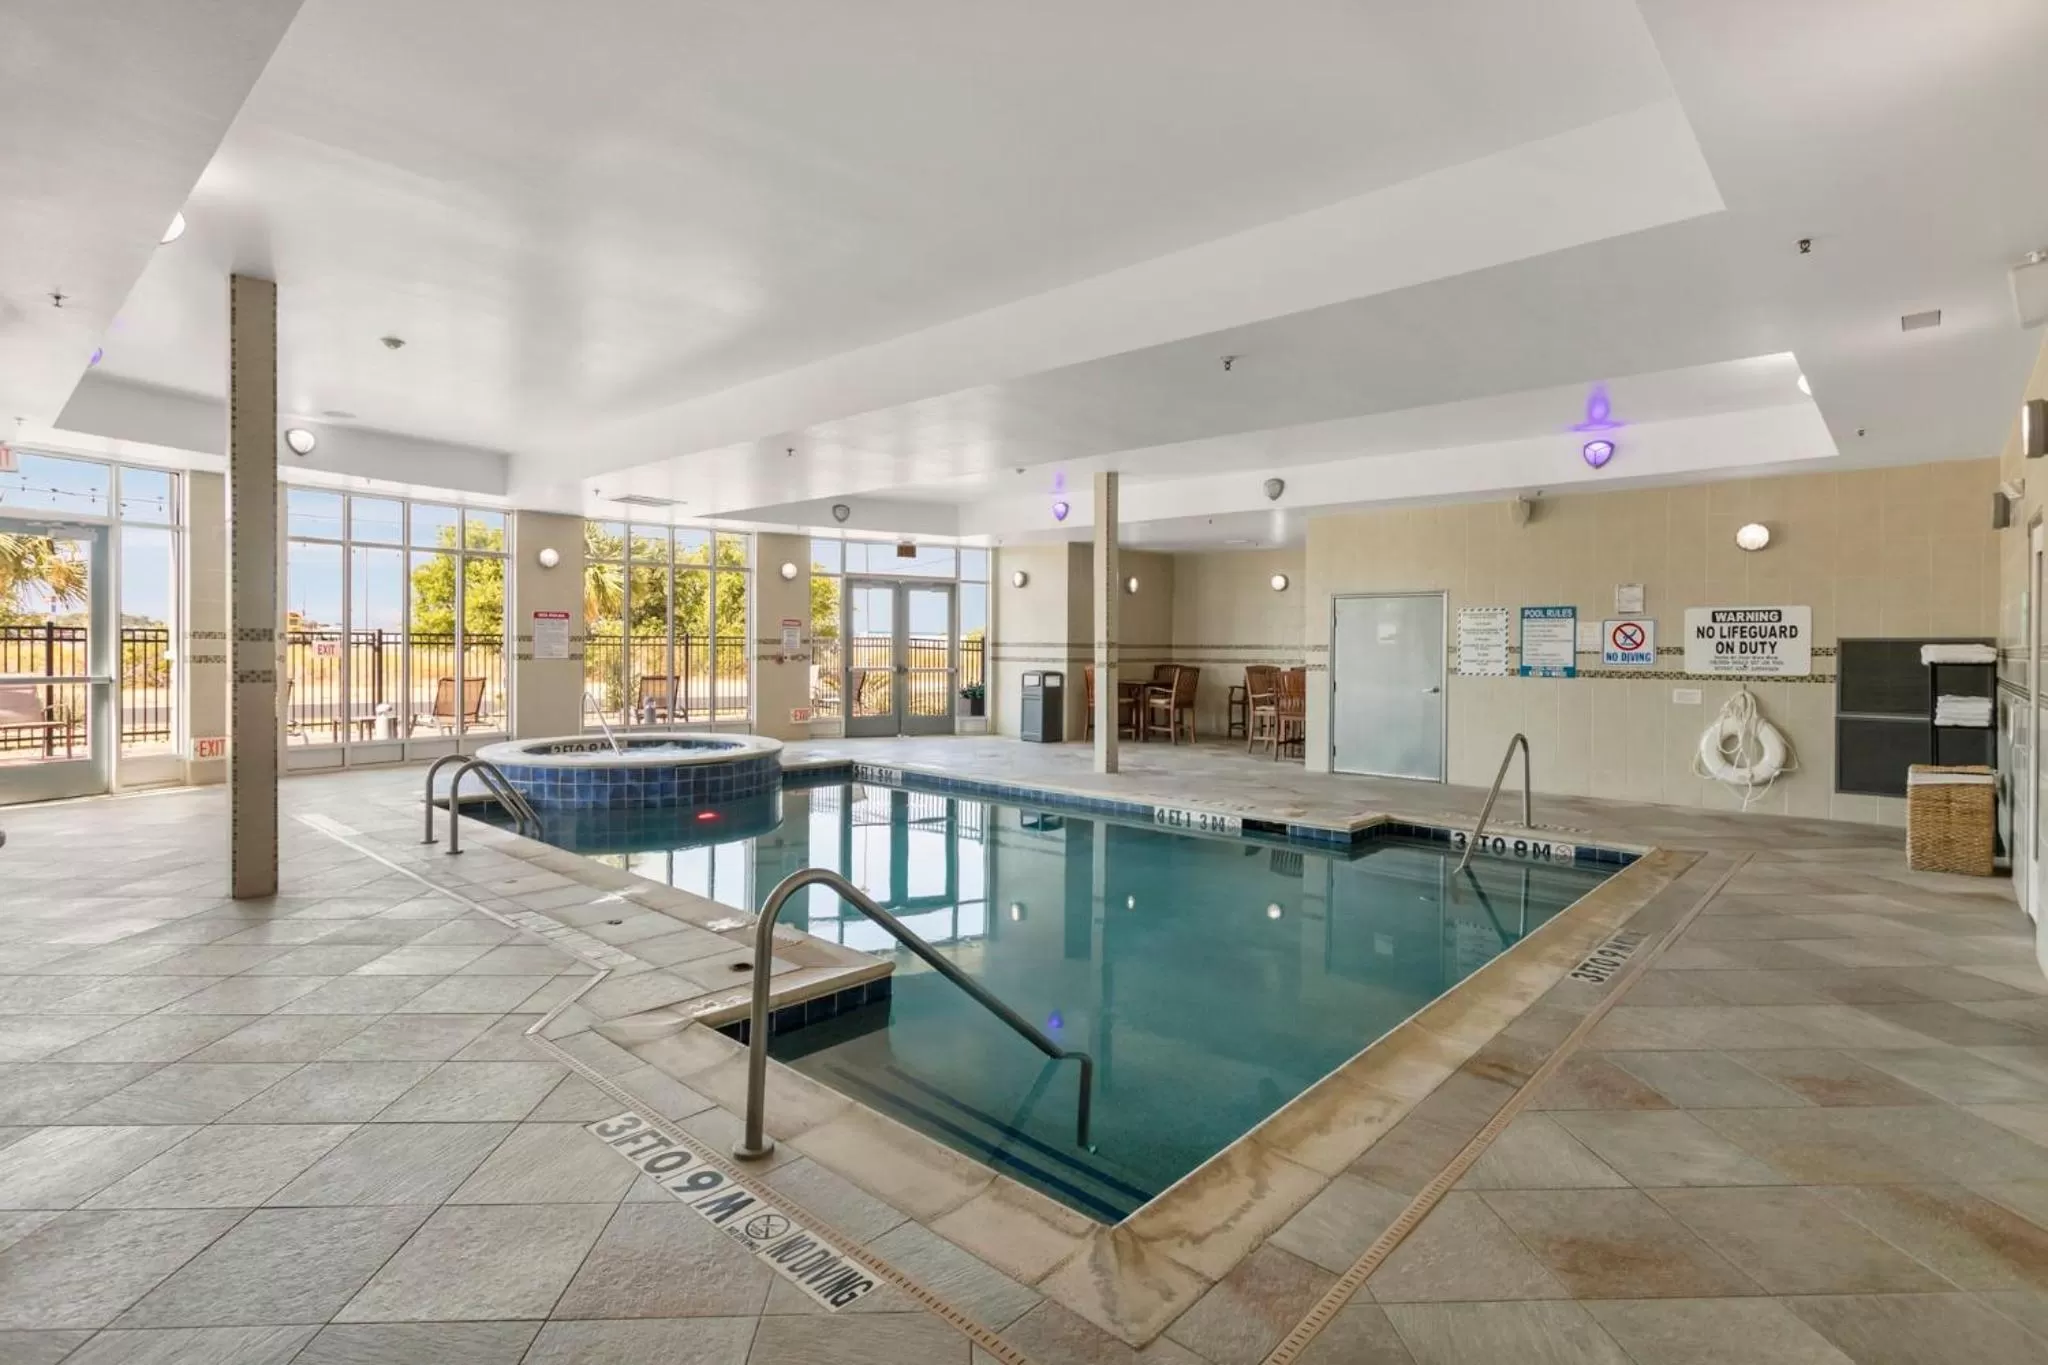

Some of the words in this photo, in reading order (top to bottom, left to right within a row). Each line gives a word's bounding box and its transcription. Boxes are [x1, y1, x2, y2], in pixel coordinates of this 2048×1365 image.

[1524, 609, 1545, 618] POOL
[1546, 608, 1572, 617] RULES
[1714, 610, 1779, 622] WARNING
[1696, 626, 1715, 639] NO
[1719, 625, 1799, 639] LIFEGUARD
[317, 644, 335, 656] EXIT
[1715, 641, 1735, 655] ON
[1739, 641, 1778, 654] DUTY
[1606, 652, 1618, 661] NO
[1621, 652, 1652, 662] DIVING
[199, 739, 226, 758] EXIT
[787, 1248, 874, 1308] DIVING
